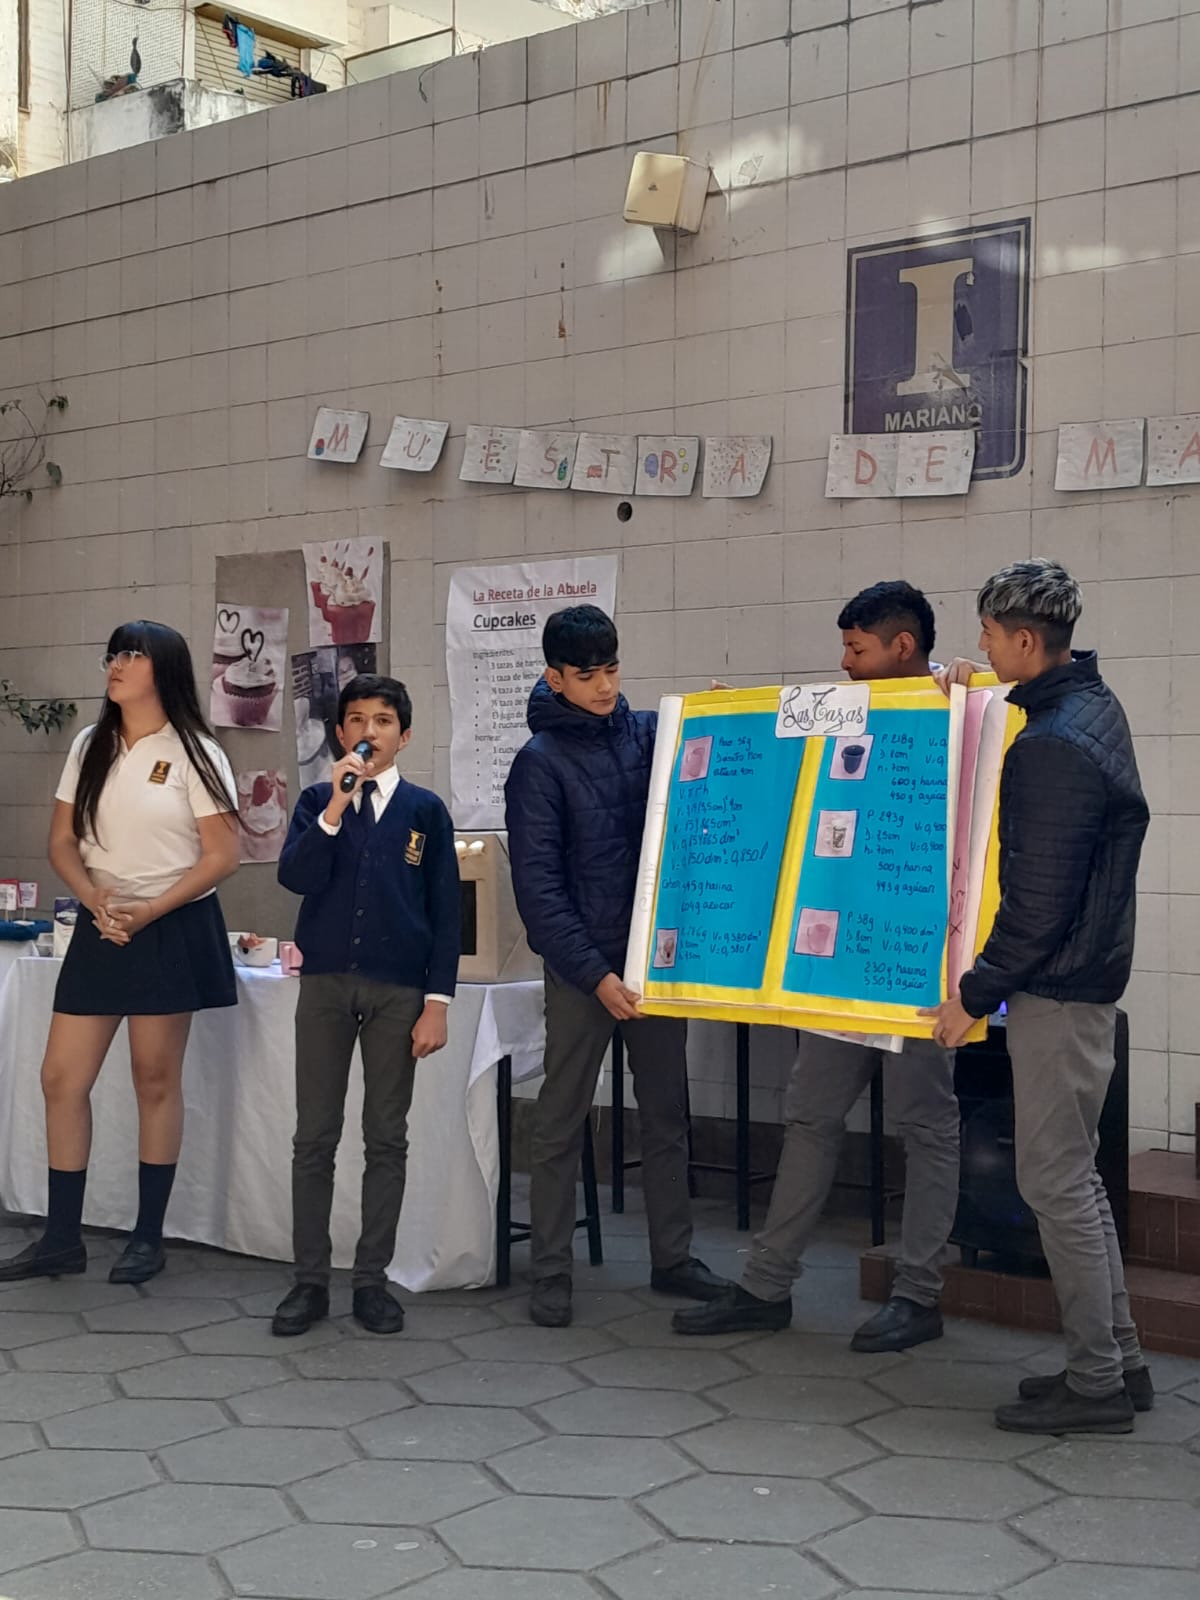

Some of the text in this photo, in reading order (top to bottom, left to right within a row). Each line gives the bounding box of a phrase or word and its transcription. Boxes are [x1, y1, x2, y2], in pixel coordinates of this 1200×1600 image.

[884, 403, 983, 433] MARIANO
[853, 445, 948, 485] DE
[473, 581, 597, 602] La Receta de la Abuela
[473, 611, 537, 631] Cupcakes
[783, 686, 864, 734] Las Tazas
